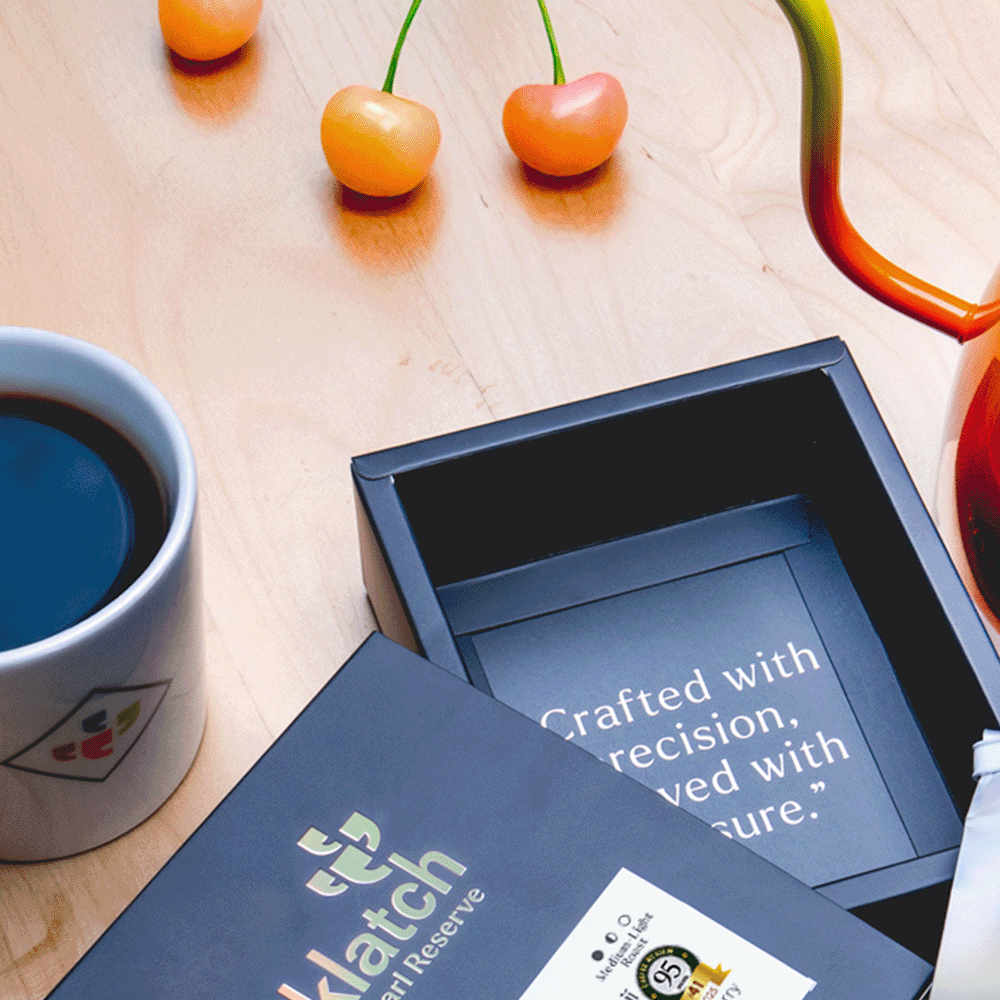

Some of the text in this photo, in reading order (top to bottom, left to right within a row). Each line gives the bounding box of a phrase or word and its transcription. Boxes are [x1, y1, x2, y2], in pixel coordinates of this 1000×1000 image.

[540, 641, 821, 741] Crafted with
[598, 705, 799, 773] recision,
[750, 731, 850, 782] with
[711, 780, 827, 840] sure.”
[403, 887, 485, 975] Reserve
[595, 912, 654, 982] Medium-Light
[620, 938, 648, 968] Roast
[653, 960, 682, 988] 95
